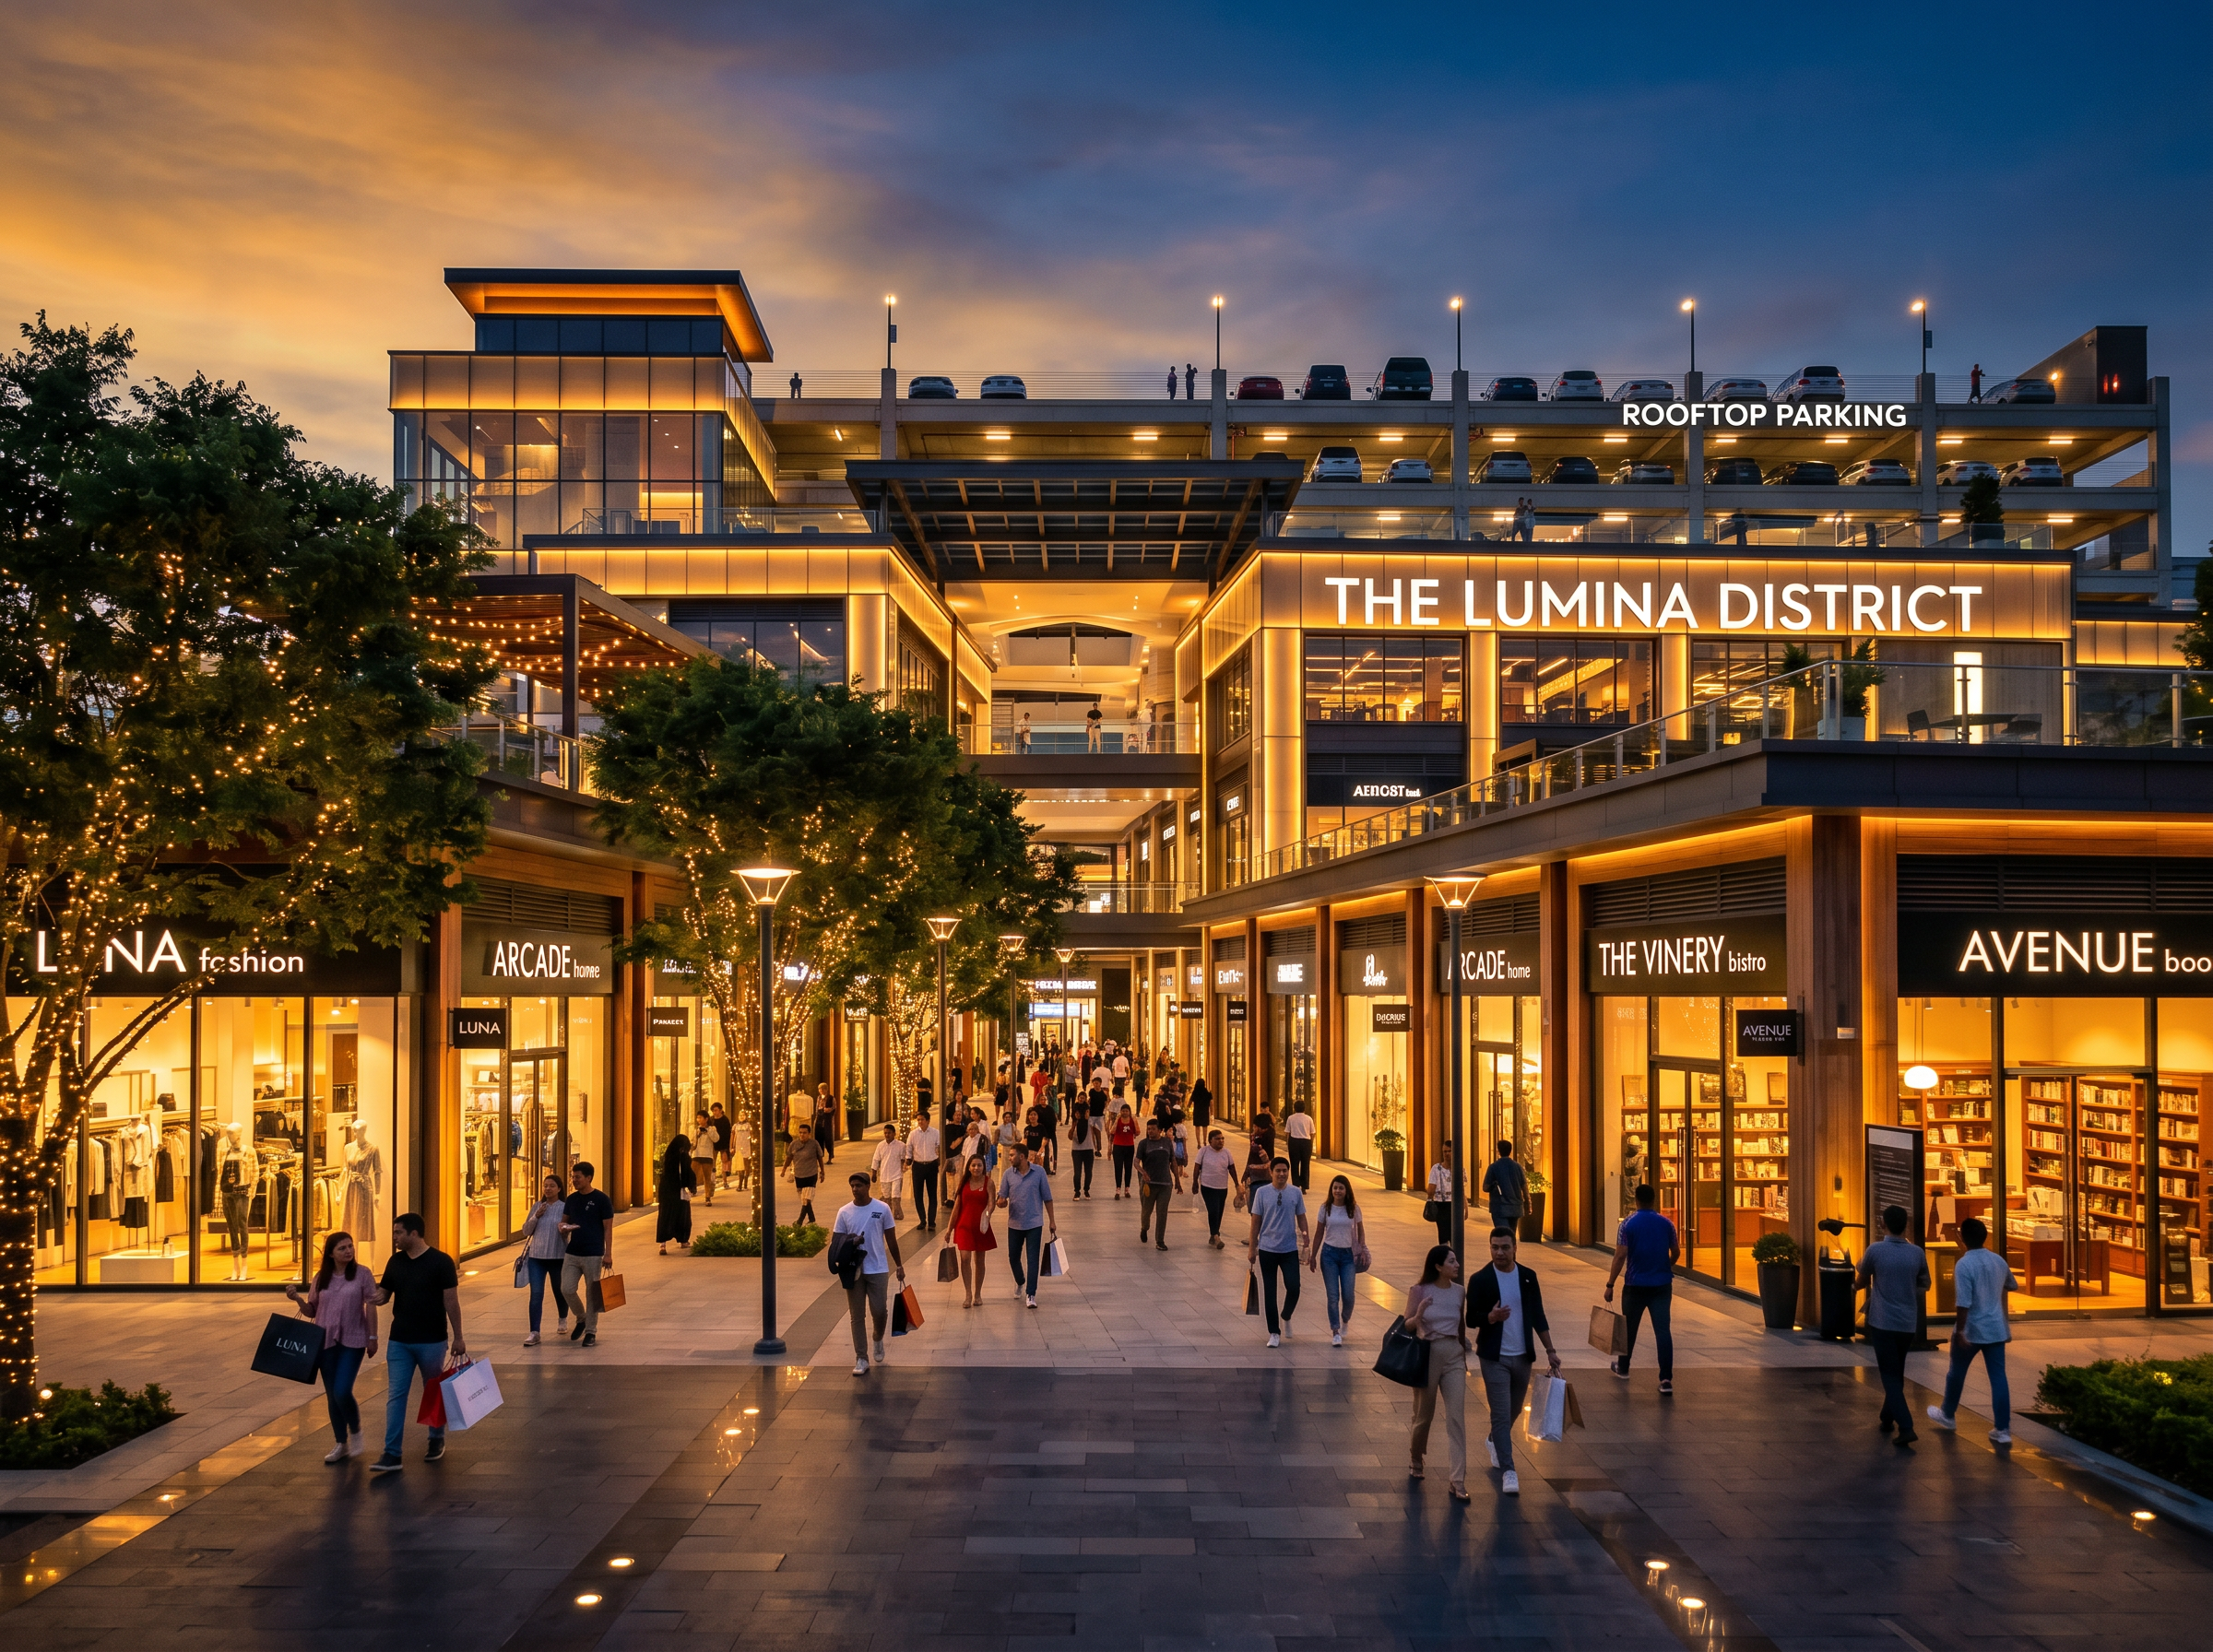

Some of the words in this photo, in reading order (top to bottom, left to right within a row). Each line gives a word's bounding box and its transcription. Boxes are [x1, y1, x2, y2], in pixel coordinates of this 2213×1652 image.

[1623, 403, 1768, 427] ROOFTOP
[1776, 404, 1907, 427] PARKING
[1325, 577, 1439, 625] THE
[1464, 580, 1699, 629] LUMINA
[1719, 583, 1982, 632] DISTRICT
[37, 929, 187, 974] LNA
[492, 940, 571, 978] ARCADE
[1598, 941, 1637, 976] THE
[1642, 935, 1725, 975] VINERY
[1728, 950, 1767, 973] bistro
[1958, 930, 2153, 973] AVENUE
[1507, 962, 1531, 979] home
[459, 1021, 501, 1034] LUNA
[1743, 1025, 1792, 1036] AVENUE
[276, 1337, 308, 1354] LUNA
